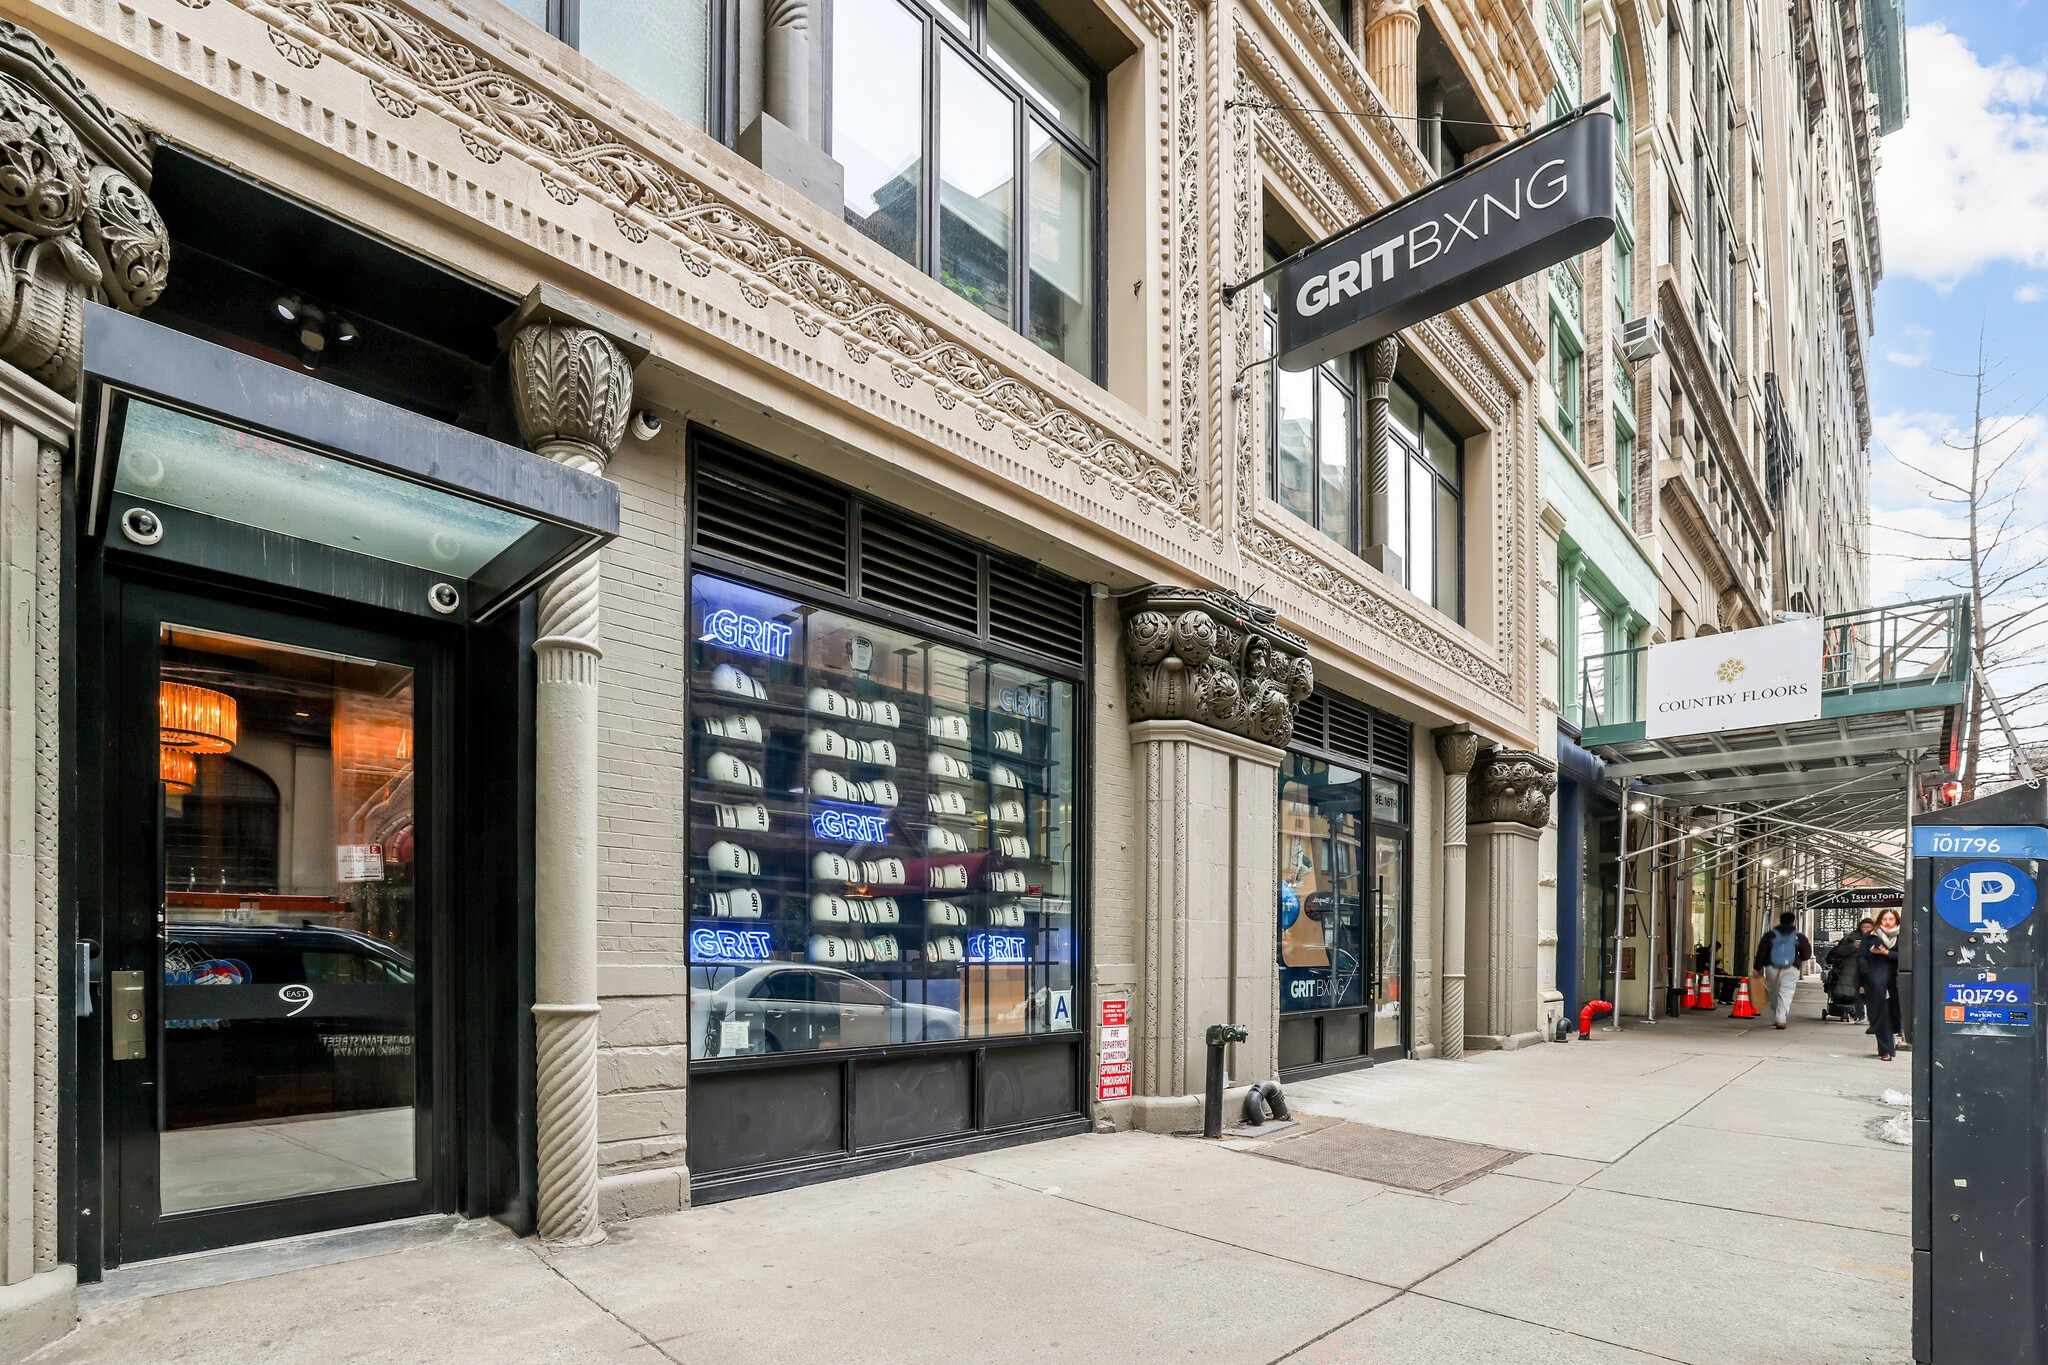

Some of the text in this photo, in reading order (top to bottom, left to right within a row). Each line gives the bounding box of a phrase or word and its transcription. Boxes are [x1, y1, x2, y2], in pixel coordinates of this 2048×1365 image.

[1296, 159, 1568, 317] GRIT BXNG
[712, 609, 792, 658] GRIT
[998, 685, 1048, 720] GRIT
[1658, 682, 1808, 713] COUNTRY FLOORS
[884, 704, 892, 721] GRIT
[738, 717, 747, 734] GRIT
[882, 743, 890, 761] GRIT
[884, 783, 892, 800] GRIT
[757, 806, 765, 826] GRIT
[821, 810, 886, 842] GRIT
[1932, 836, 2001, 853] 101796
[889, 861, 897, 879] GRIT
[750, 893, 758, 914] GRIT
[1969, 871, 2016, 924] P
[885, 901, 893, 918] GRIT
[692, 928, 770, 958] GRIT
[885, 939, 893, 956] GRIT
[977, 933, 1025, 960] GRIT
[286, 990, 306, 998] EAST
[1291, 978, 1344, 998] GRIT BXNG
[1955, 988, 2018, 1004] 101796
[278, 984, 314, 1017] 9
[1054, 995, 1069, 1020] A
[1110, 1029, 1120, 1038] FIRE
[1102, 1040, 1128, 1050] DEPARTMENT
[1103, 1050, 1127, 1061] CONNECTION
[1100, 1063, 1131, 1075] SPRINKLERS
[1101, 1075, 1130, 1086] THROUGHOUT
[1103, 1086, 1128, 1098] BUILDING
